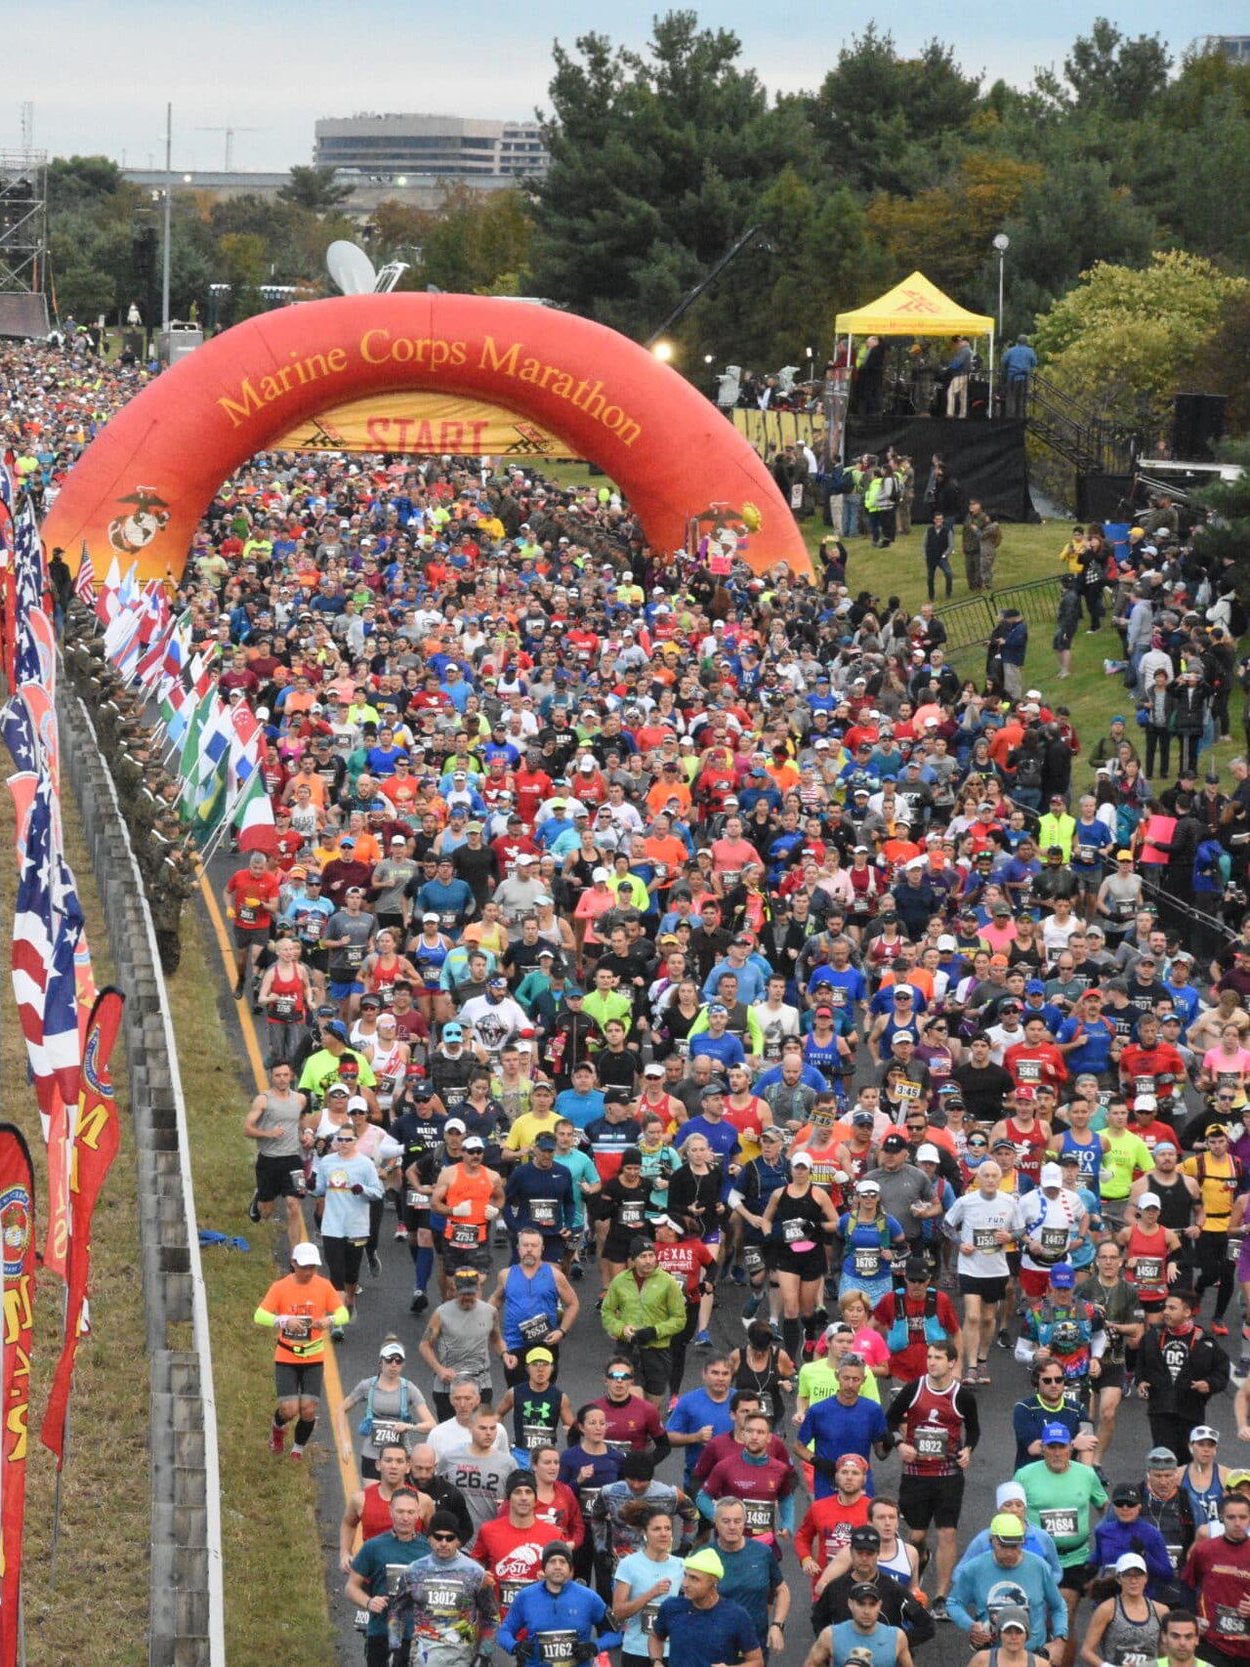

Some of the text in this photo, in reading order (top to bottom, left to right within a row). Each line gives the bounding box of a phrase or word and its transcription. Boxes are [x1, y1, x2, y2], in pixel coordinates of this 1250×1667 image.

[217, 328, 644, 448] Marine Corps Marathon
[365, 416, 490, 455] START
[897, 1085, 919, 1097] 3:45
[811, 1114, 831, 1126] 3:45
[1020, 1161, 1039, 1170] WB
[988, 1216, 1005, 1224] run
[658, 1248, 693, 1261] TEXAS
[1166, 1350, 1184, 1365] DC
[919, 1440, 942, 1452] 8922
[456, 1470, 499, 1491] 26.2
[1045, 1518, 1075, 1531] 21684
[428, 1591, 456, 1605] 13012
[543, 1642, 573, 1658] 11762
